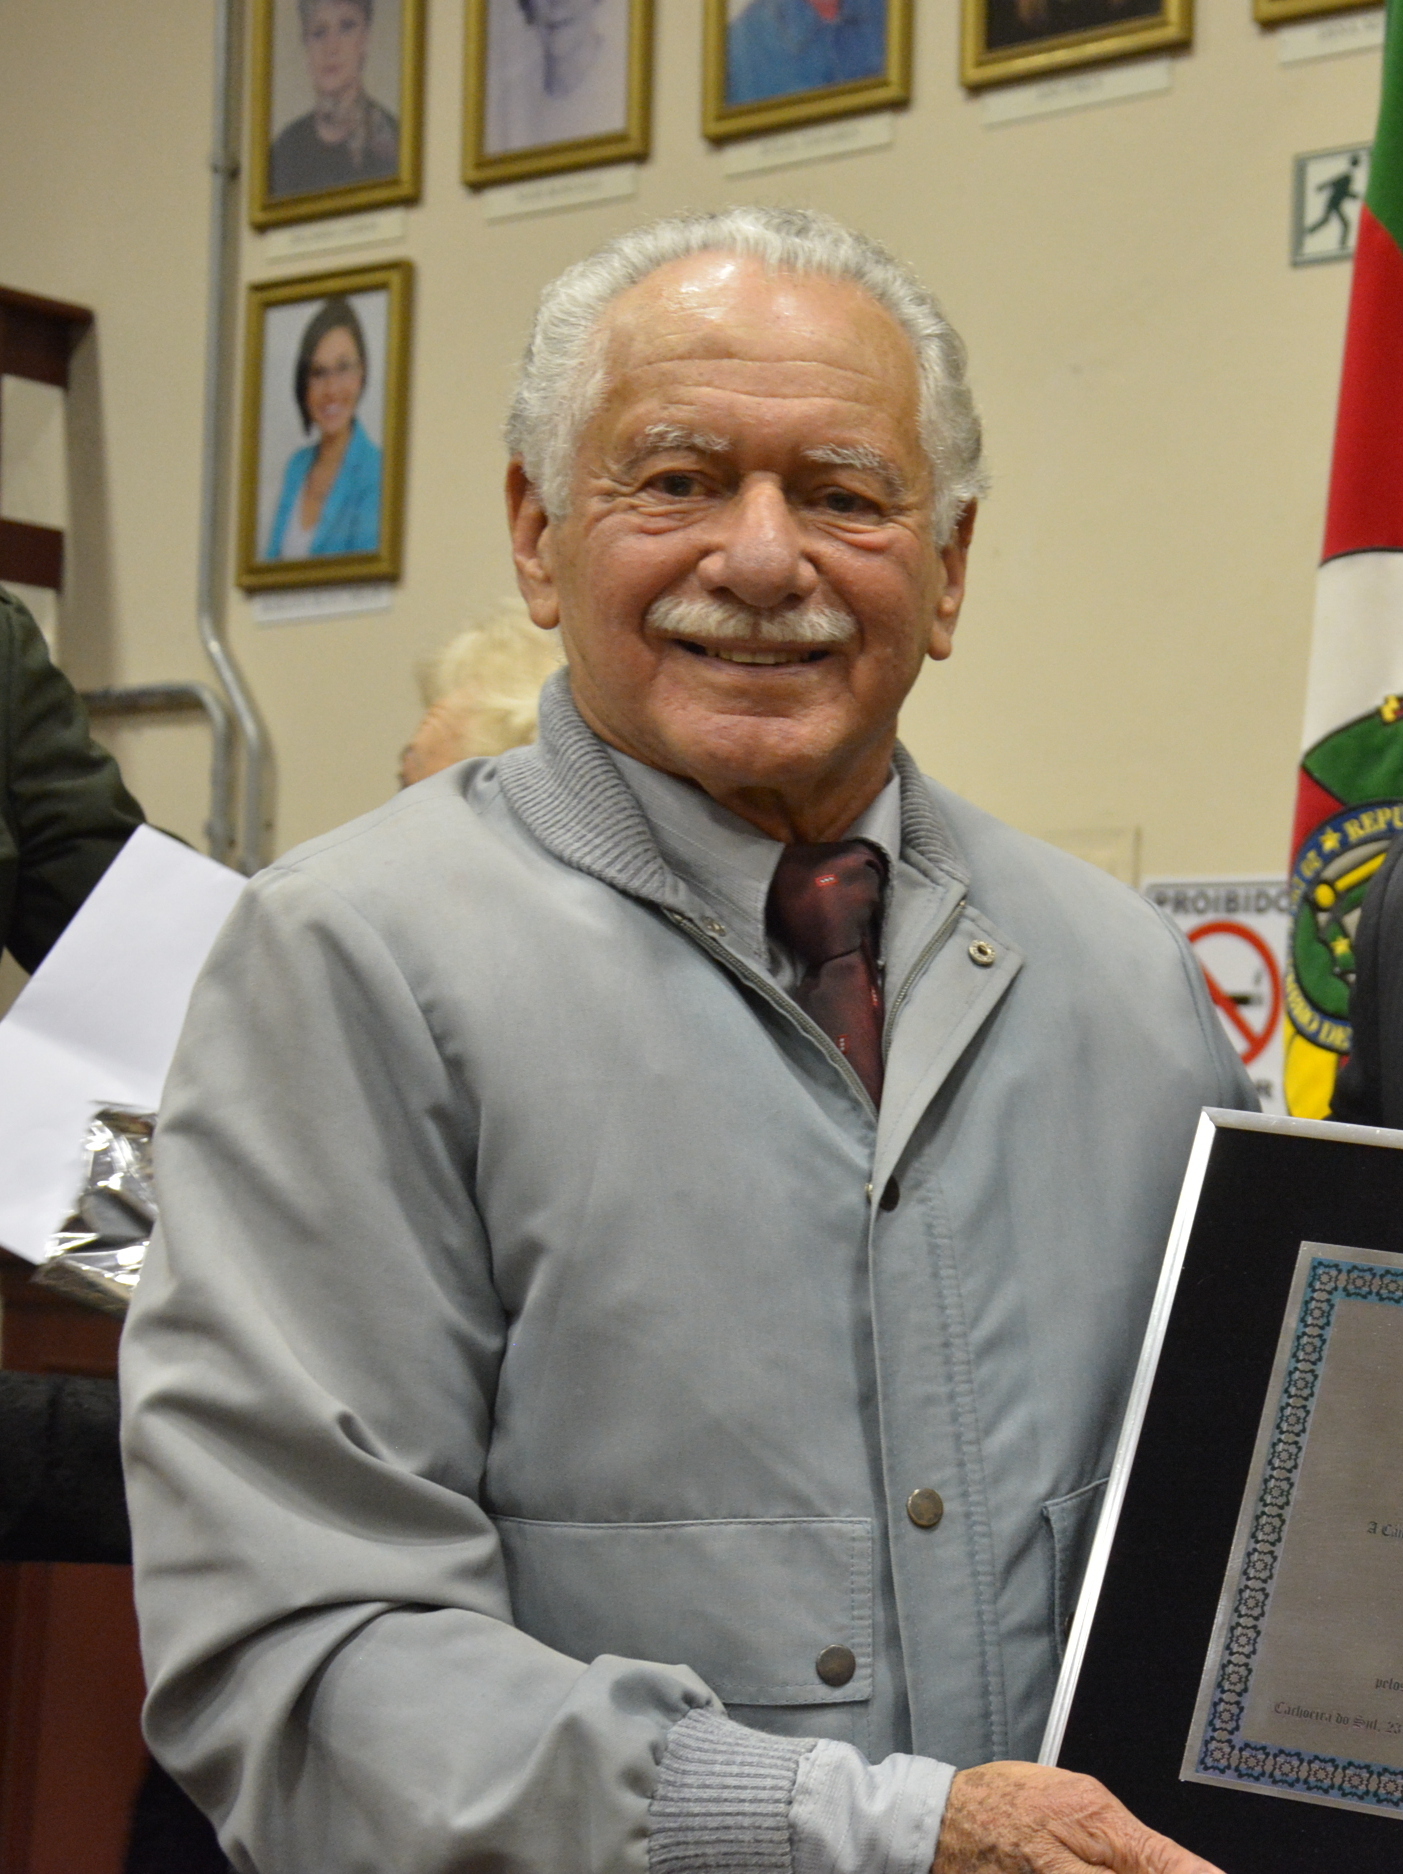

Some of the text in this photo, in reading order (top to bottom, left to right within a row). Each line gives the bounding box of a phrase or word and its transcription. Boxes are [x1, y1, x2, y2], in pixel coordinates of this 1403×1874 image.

[1366, 1520, 1378, 1535] A
[1274, 1700, 1332, 1723] Cachoeira
[1335, 1712, 1350, 1726] do
[1384, 1720, 1402, 1735] 23
